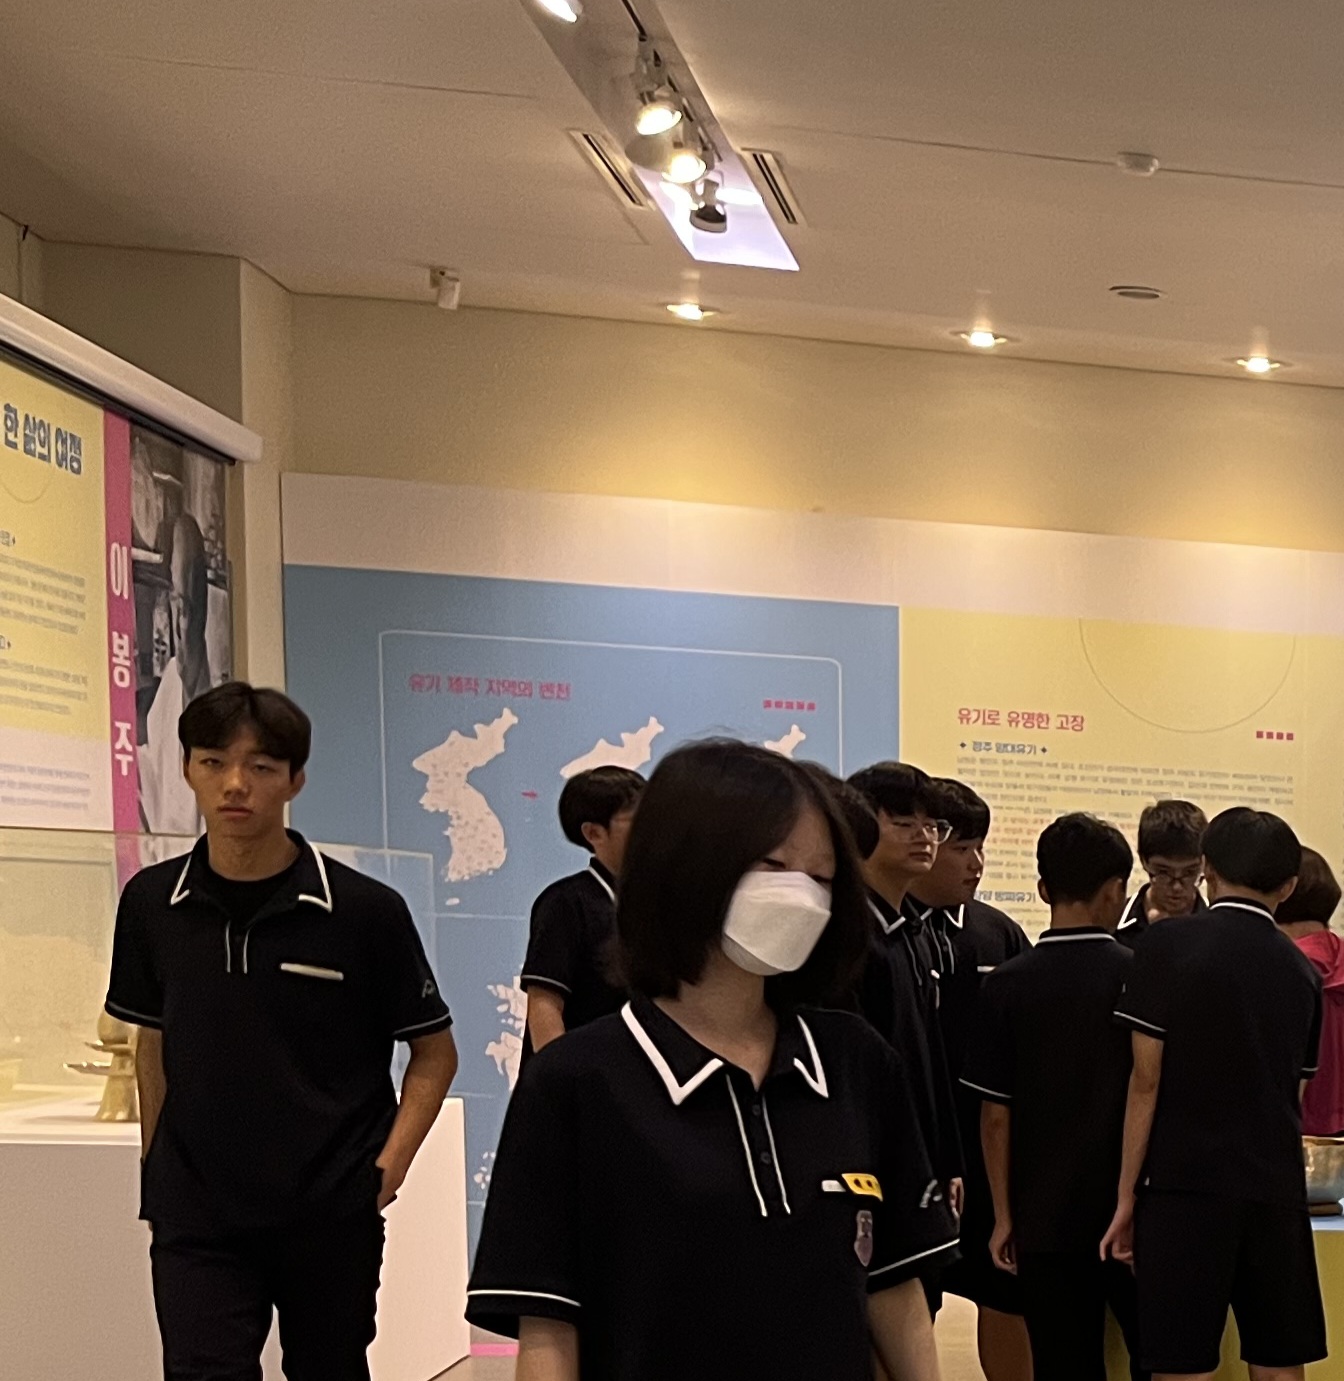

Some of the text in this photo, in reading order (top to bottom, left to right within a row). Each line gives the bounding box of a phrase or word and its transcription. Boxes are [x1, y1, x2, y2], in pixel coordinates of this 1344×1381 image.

[3, 403, 82, 475] 한 삶의 여정
[957, 707, 1085, 733] 유기로 유명한 고장
